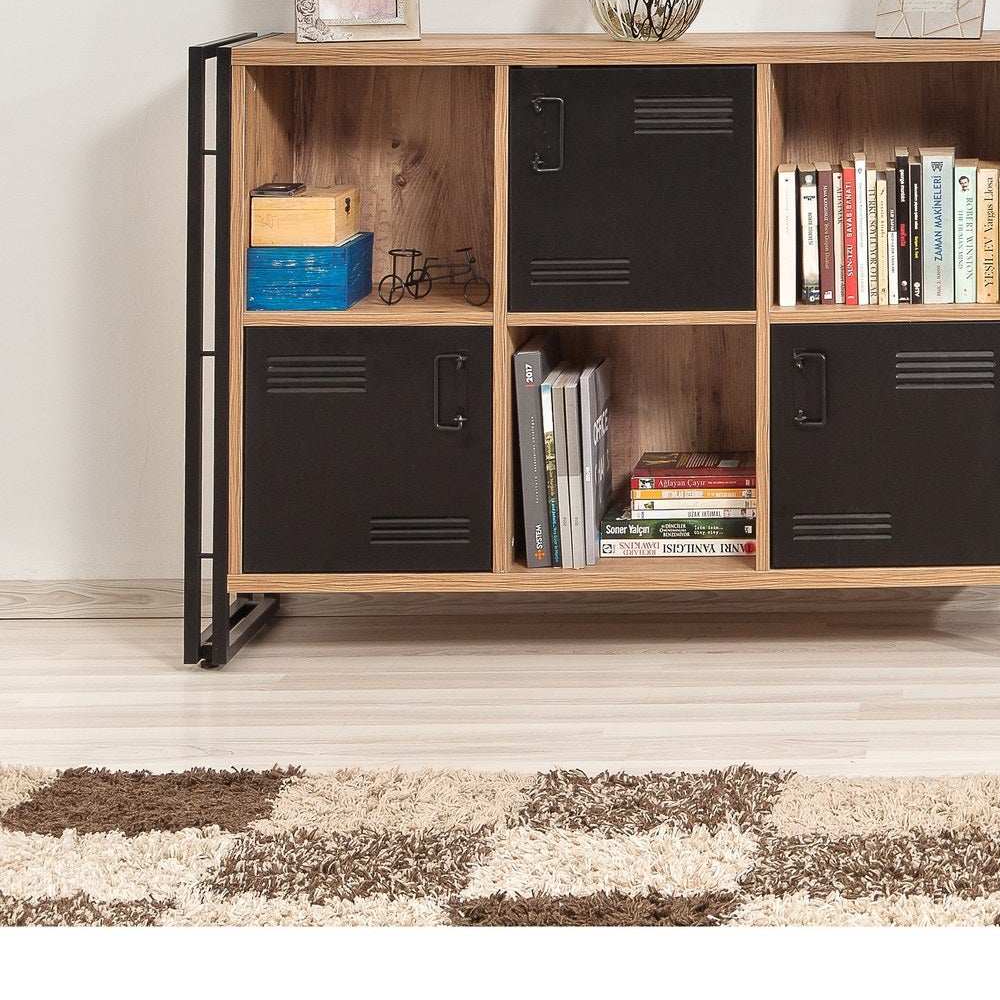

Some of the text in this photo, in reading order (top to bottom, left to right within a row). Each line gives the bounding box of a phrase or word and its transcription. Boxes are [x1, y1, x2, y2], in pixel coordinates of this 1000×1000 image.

[984, 177, 993, 201] Llosa
[931, 175, 942, 228] MAKİNELERİ
[984, 203, 995, 233] Vargas
[933, 231, 943, 262] ZAMAN
[965, 197, 974, 280] ROBERT WINSTON
[525, 363, 534, 383] 2017
[658, 480, 686, 489] Ağlayan
[535, 524, 543, 550] SYSTEM
[605, 524, 650, 537] Soner Yalçın
[619, 542, 660, 550] DAWKINS
[663, 543, 716, 553] YANILGISI
